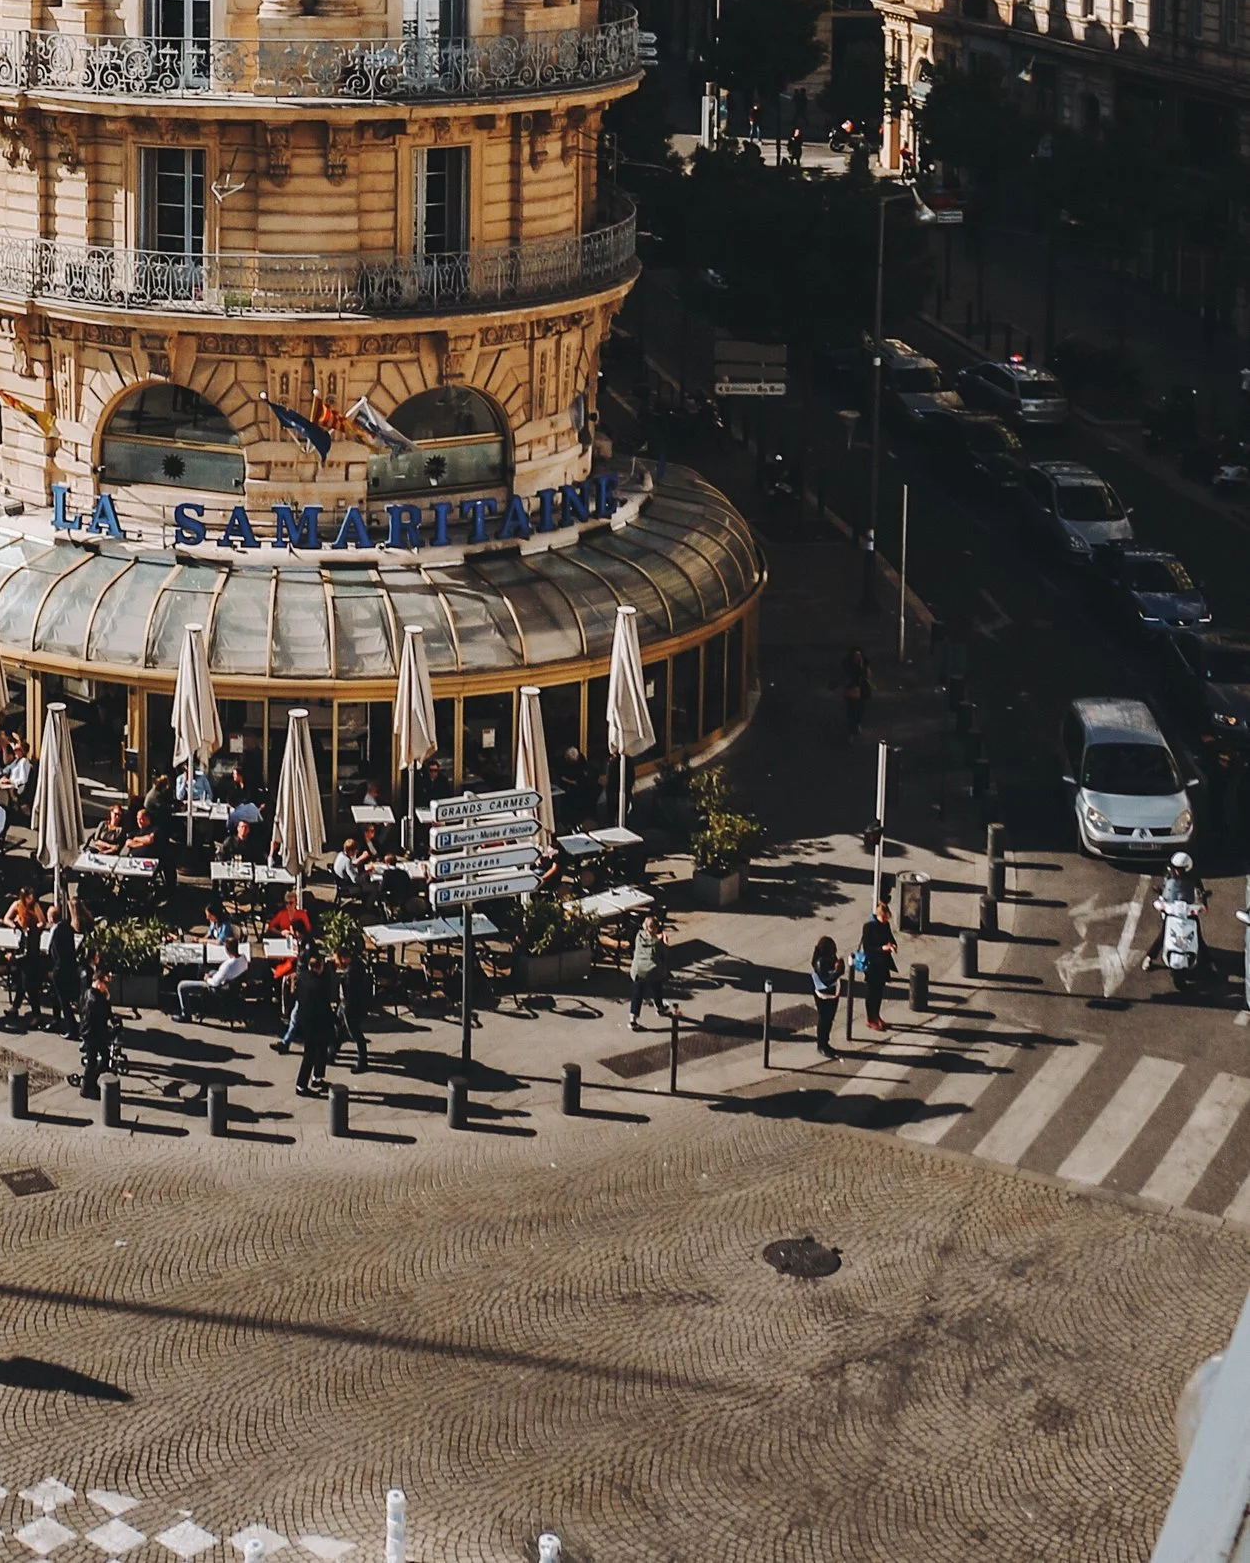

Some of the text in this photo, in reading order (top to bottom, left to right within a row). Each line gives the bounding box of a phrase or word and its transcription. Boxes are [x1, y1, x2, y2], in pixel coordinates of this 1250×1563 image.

[52, 472, 619, 550] LA SAMARITAINE
[441, 796, 530, 817] GRANDS CARMES
[453, 834, 475, 844] Bourse
[480, 829, 500, 838] Musée
[454, 858, 500, 871] Phocéens
[453, 884, 509, 898] République
